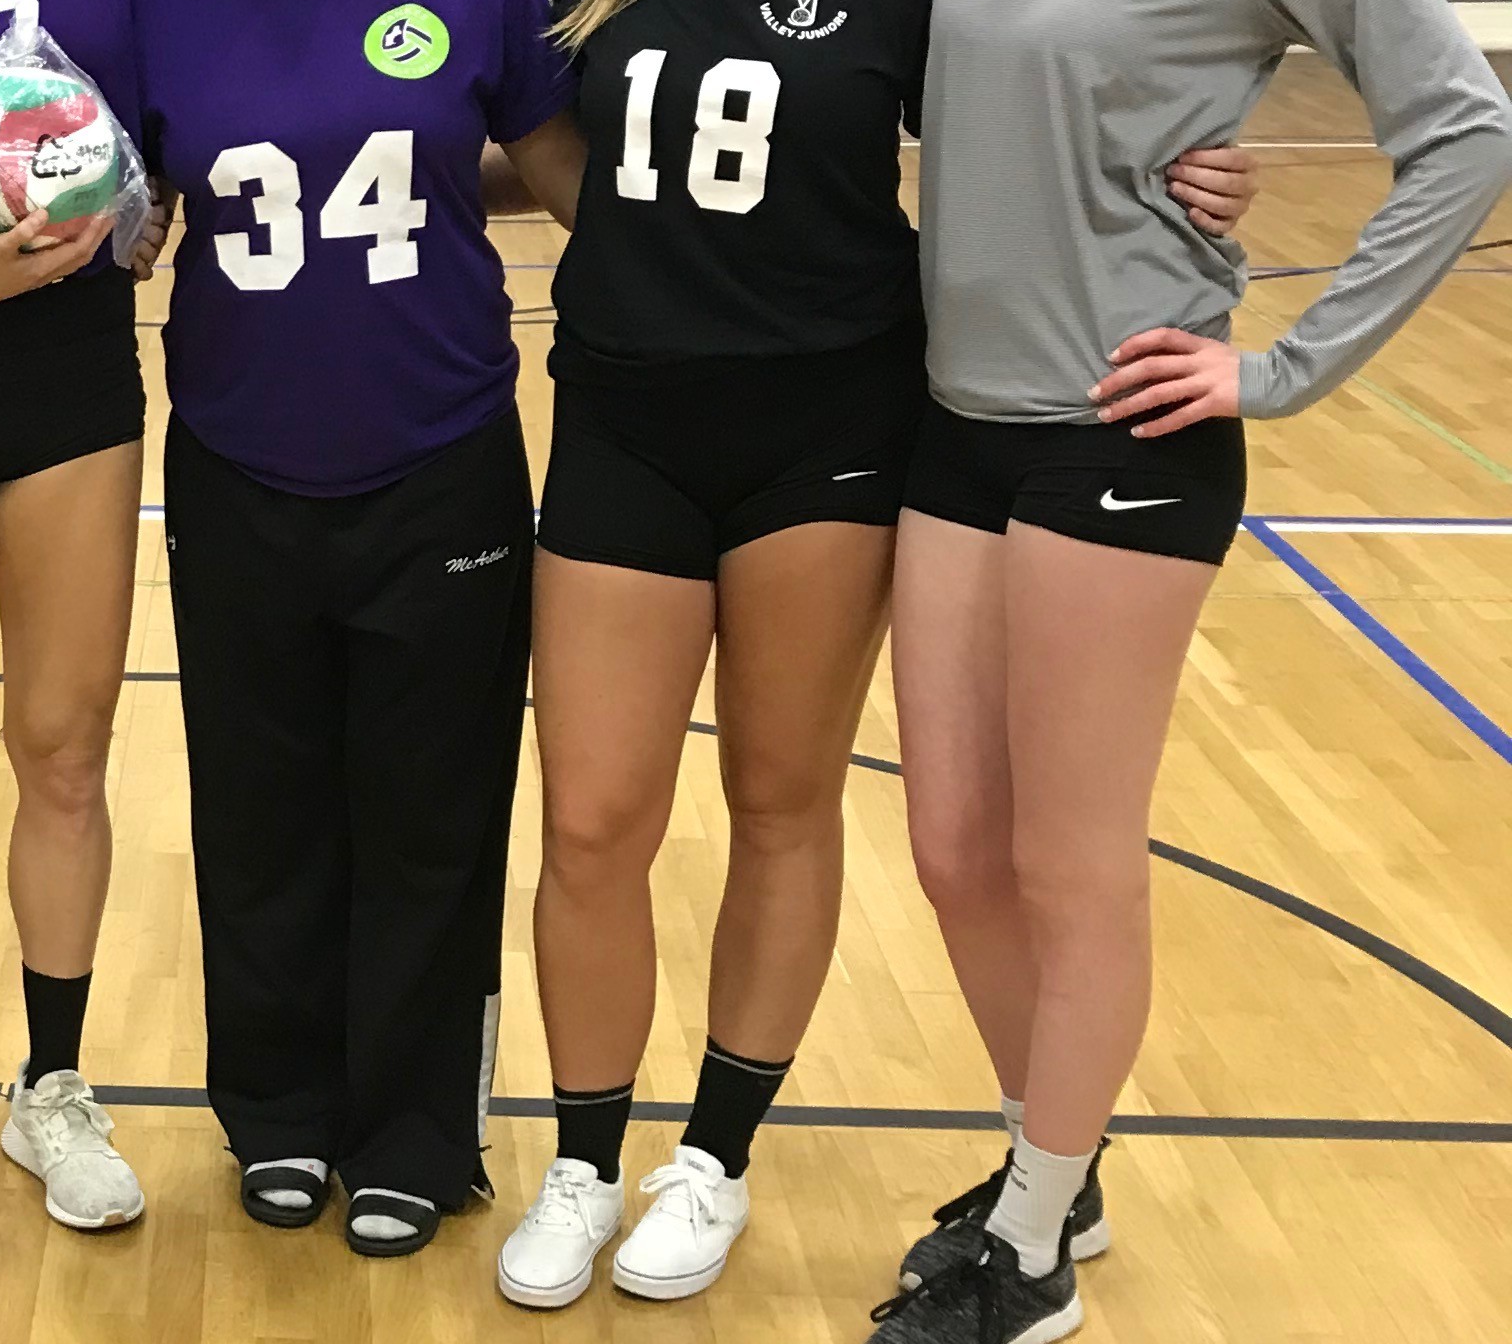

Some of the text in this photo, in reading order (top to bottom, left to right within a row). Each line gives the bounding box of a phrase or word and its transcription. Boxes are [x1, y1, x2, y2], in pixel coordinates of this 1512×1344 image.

[759, 2, 848, 40] VALLEY JUNIORS
[207, 130, 427, 291] 34
[616, 48, 781, 214] 18
